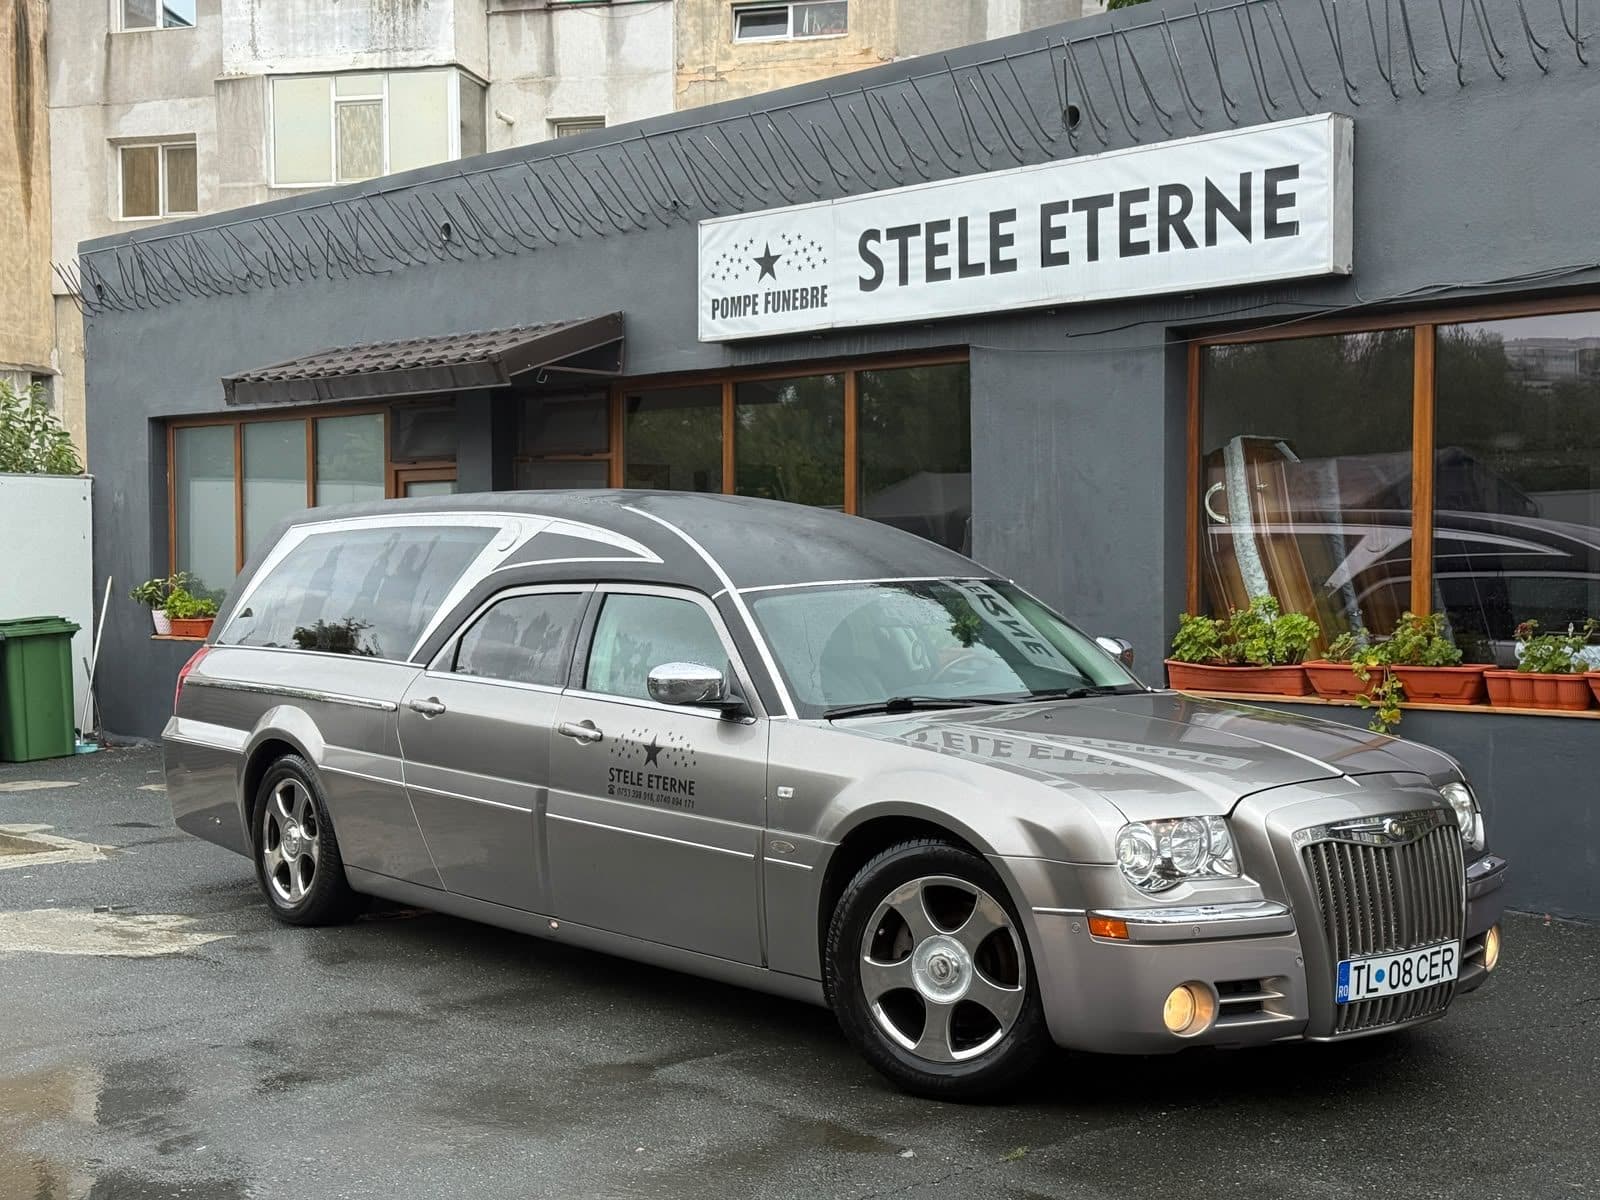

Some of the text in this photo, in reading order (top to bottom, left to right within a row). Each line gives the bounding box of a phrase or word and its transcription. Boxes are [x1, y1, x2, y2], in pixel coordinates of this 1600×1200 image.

[858, 164, 1299, 292] STELE ETERNE
[711, 285, 828, 320] POMPE FUNEBRE
[608, 767, 695, 796] STELE ETERNE
[1353, 947, 1454, 996] TL 08 CER
[1338, 984, 1349, 998] RO
